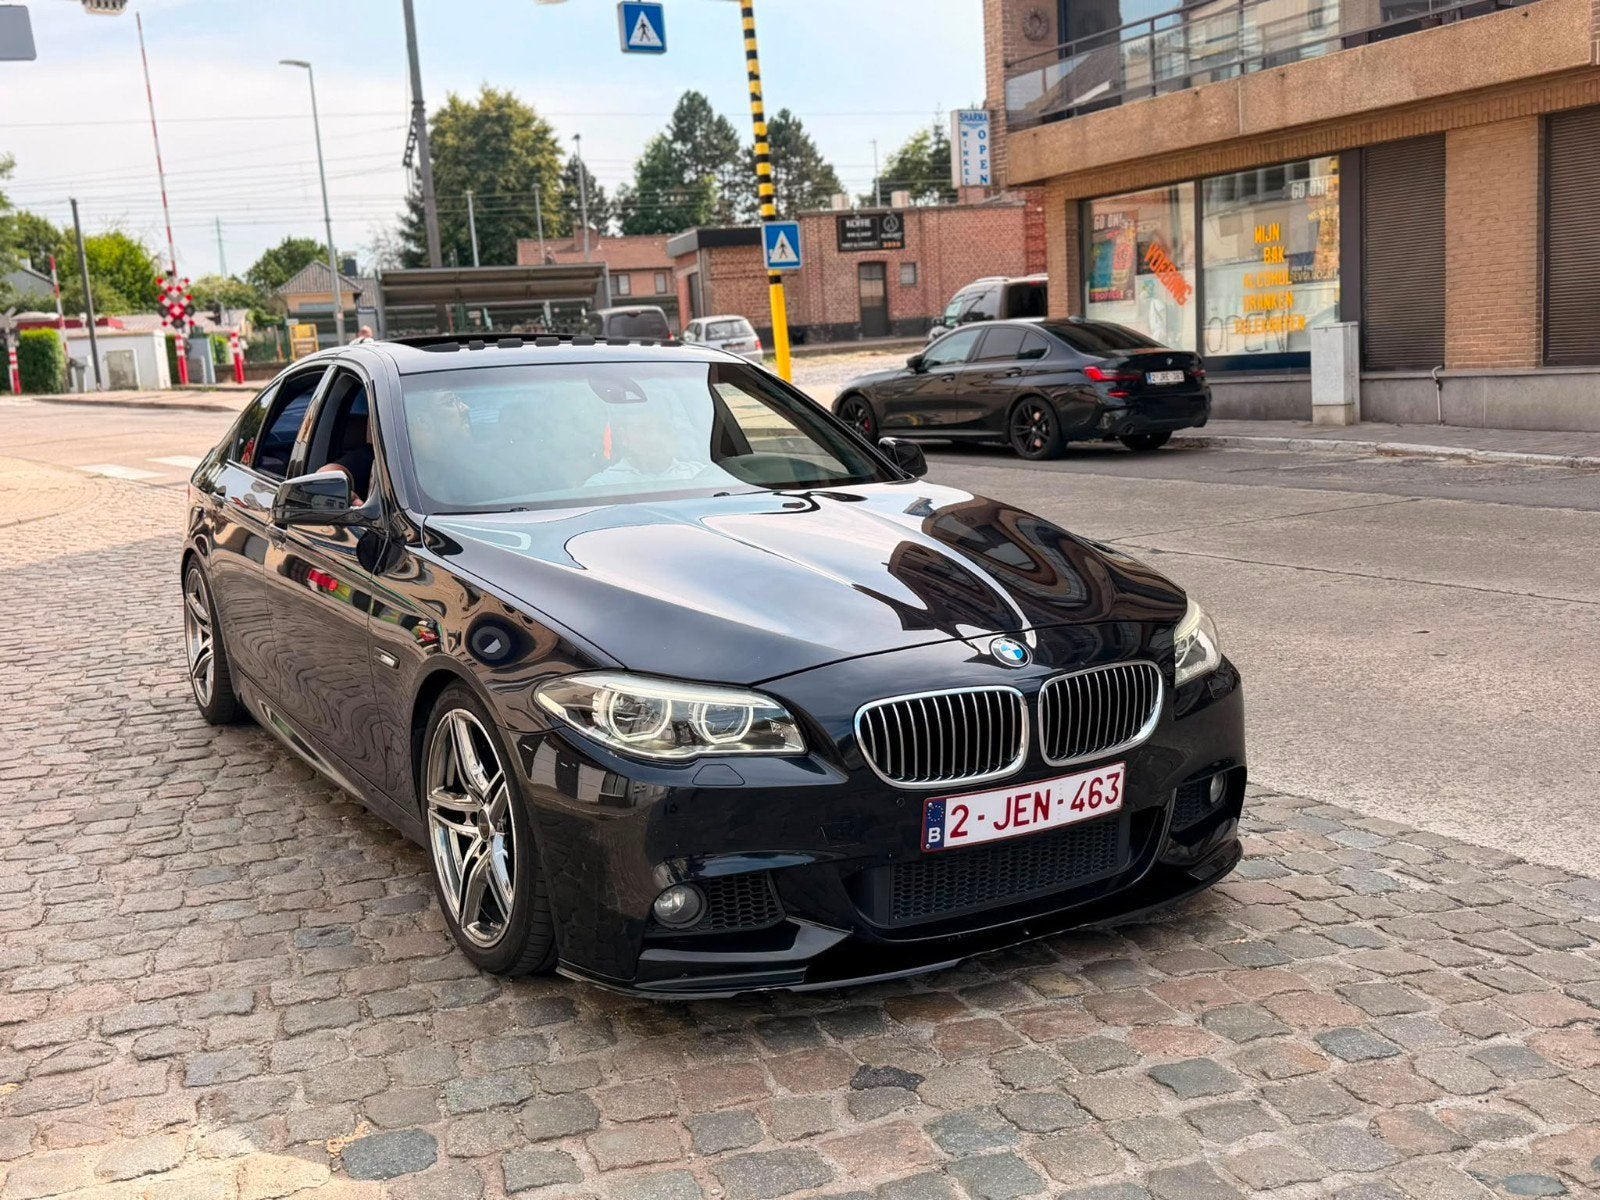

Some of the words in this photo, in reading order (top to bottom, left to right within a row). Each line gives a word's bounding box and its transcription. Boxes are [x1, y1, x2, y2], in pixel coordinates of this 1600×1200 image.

[978, 129, 988, 184] OPEN
[1291, 182, 1306, 199] GO
[1093, 215, 1106, 230] GO
[1253, 223, 1281, 244] WIJN
[1264, 245, 1286, 265] BAK
[1144, 241, 1193, 307] VOEDING
[1243, 268, 1292, 289] ALCOHOL
[1242, 291, 1295, 313] DRANKEN
[928, 827, 941, 844] B
